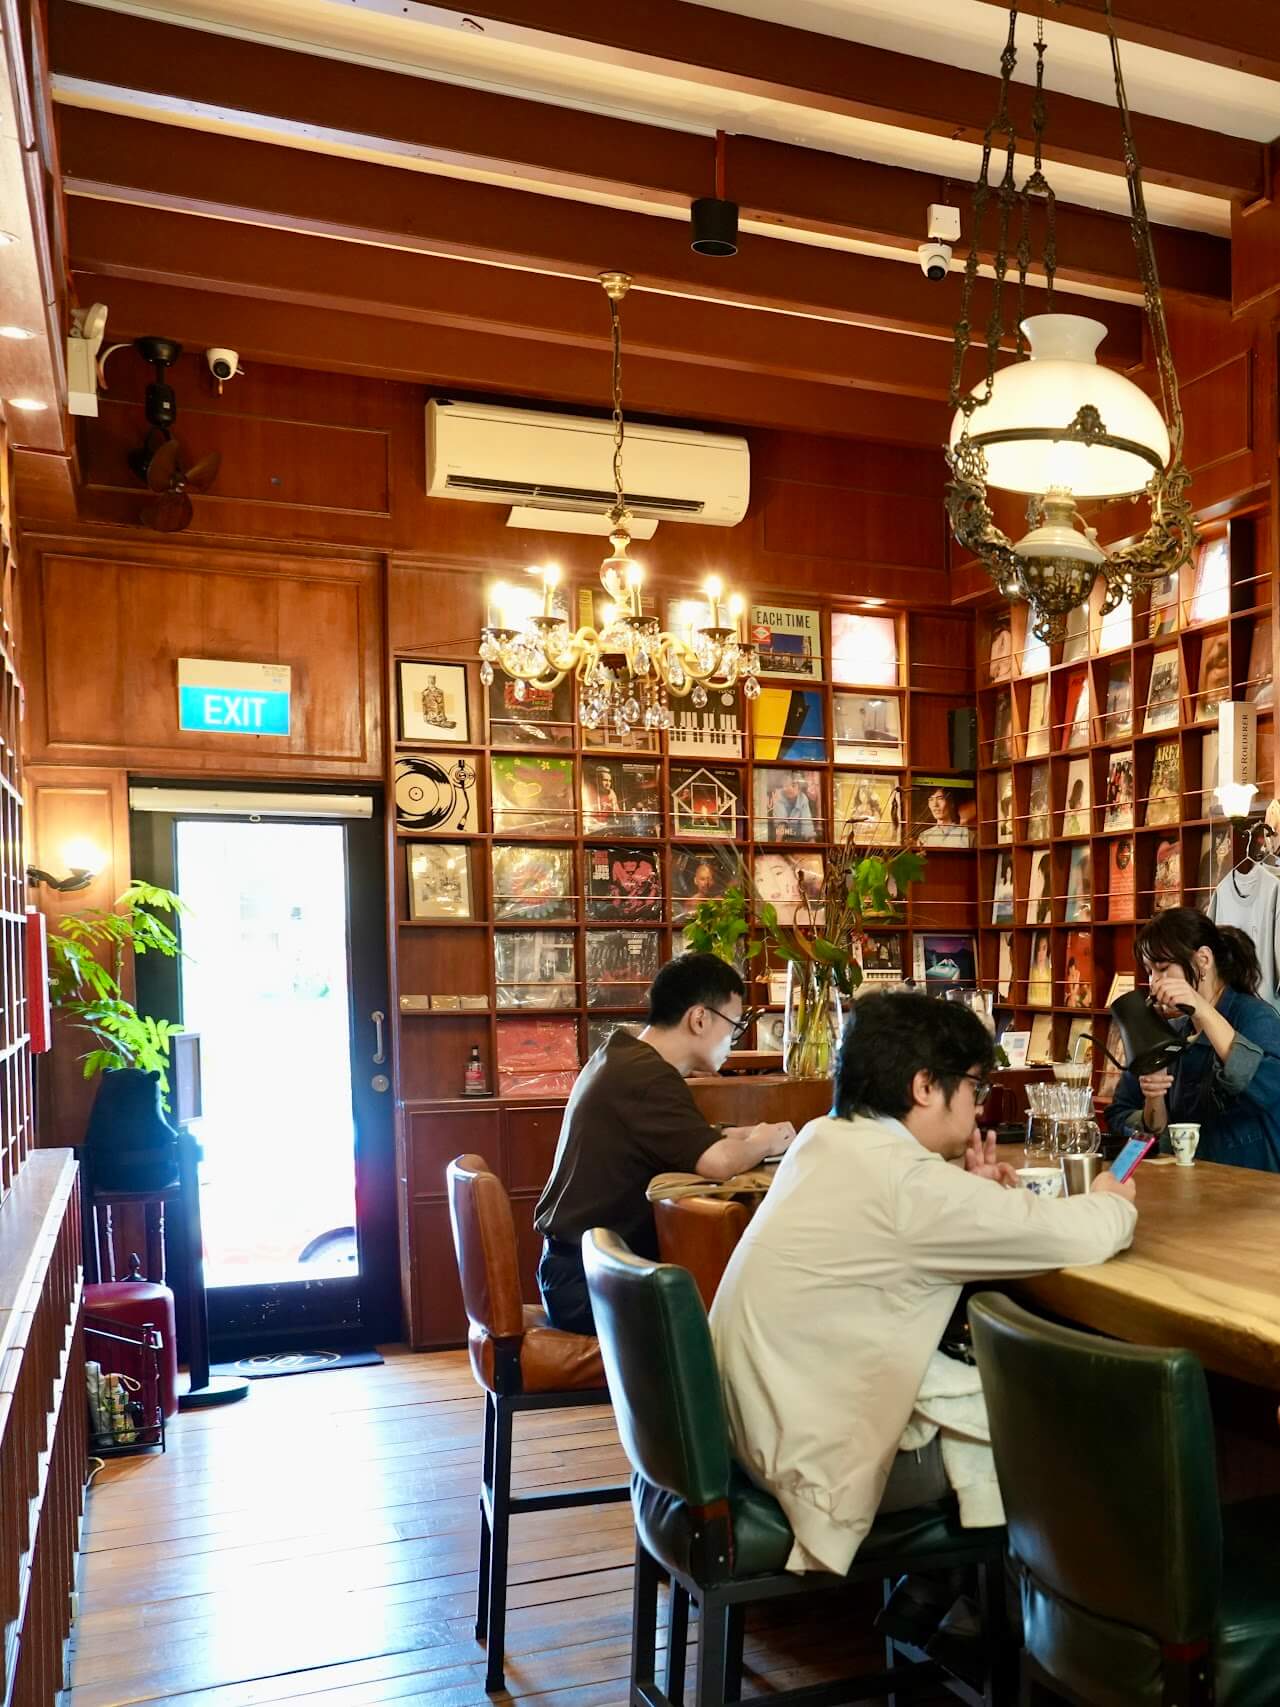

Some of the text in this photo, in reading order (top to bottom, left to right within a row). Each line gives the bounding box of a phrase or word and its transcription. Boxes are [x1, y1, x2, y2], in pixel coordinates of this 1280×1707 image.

[756, 611, 811, 629] EACH TIME
[204, 694, 268, 727] EXIT
[1240, 713, 1249, 764] ROEDERER
